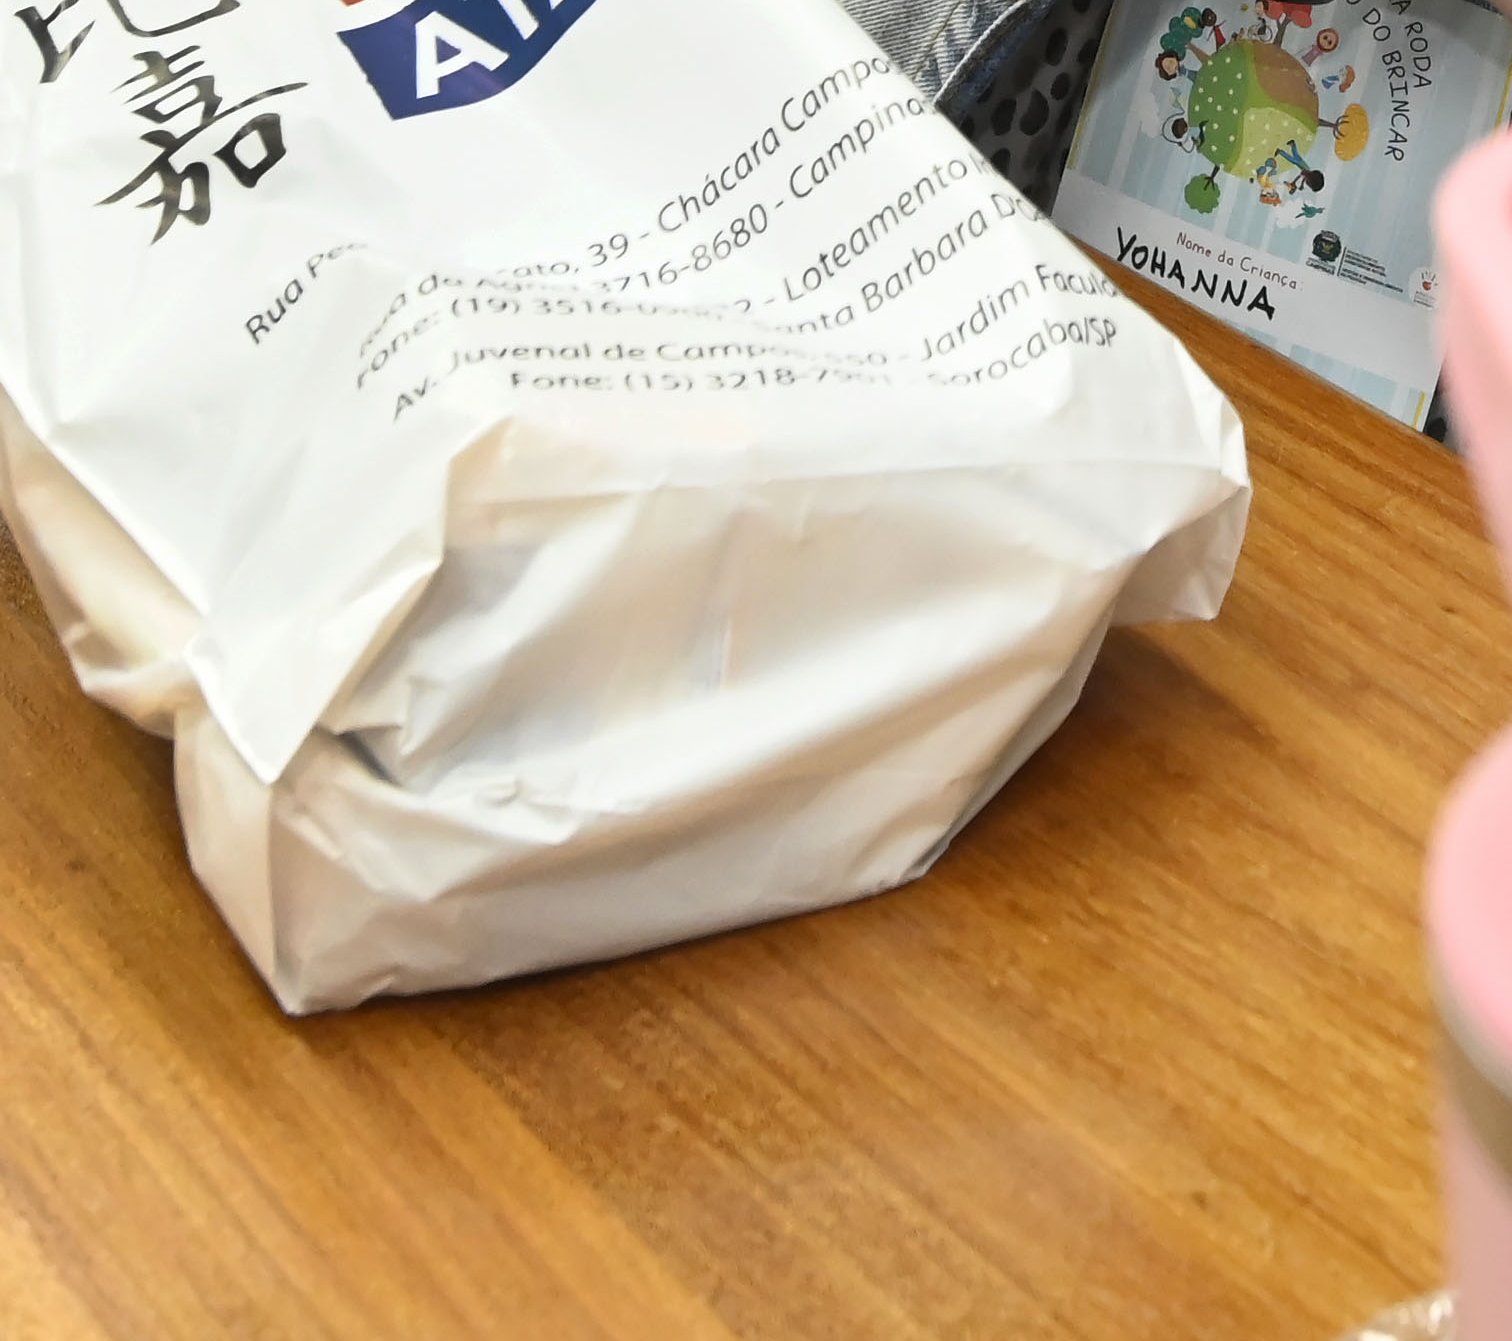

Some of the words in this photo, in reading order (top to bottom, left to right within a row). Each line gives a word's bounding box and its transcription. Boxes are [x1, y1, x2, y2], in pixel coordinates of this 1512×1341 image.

[1362, 8, 1391, 42] DO
[1381, 50, 1410, 162] BRINCAR
[1404, 21, 1433, 89] RODA
[245, 279, 304, 345] Rua
[588, 233, 629, 267] 39
[658, 127, 782, 233] Chácara
[780, 56, 892, 132] Campo
[593, 203, 768, 293] 3716-8680
[789, 95, 927, 199] Campina
[783, 158, 968, 302] Loteamento
[860, 209, 988, 313] Barbara
[1116, 226, 1277, 322] YOHANNA
[1177, 232, 1213, 259] Nome
[1218, 251, 1235, 268] da
[447, 342, 592, 374] Juvenal
[603, 343, 645, 362] de
[921, 279, 1031, 361] Jardim
